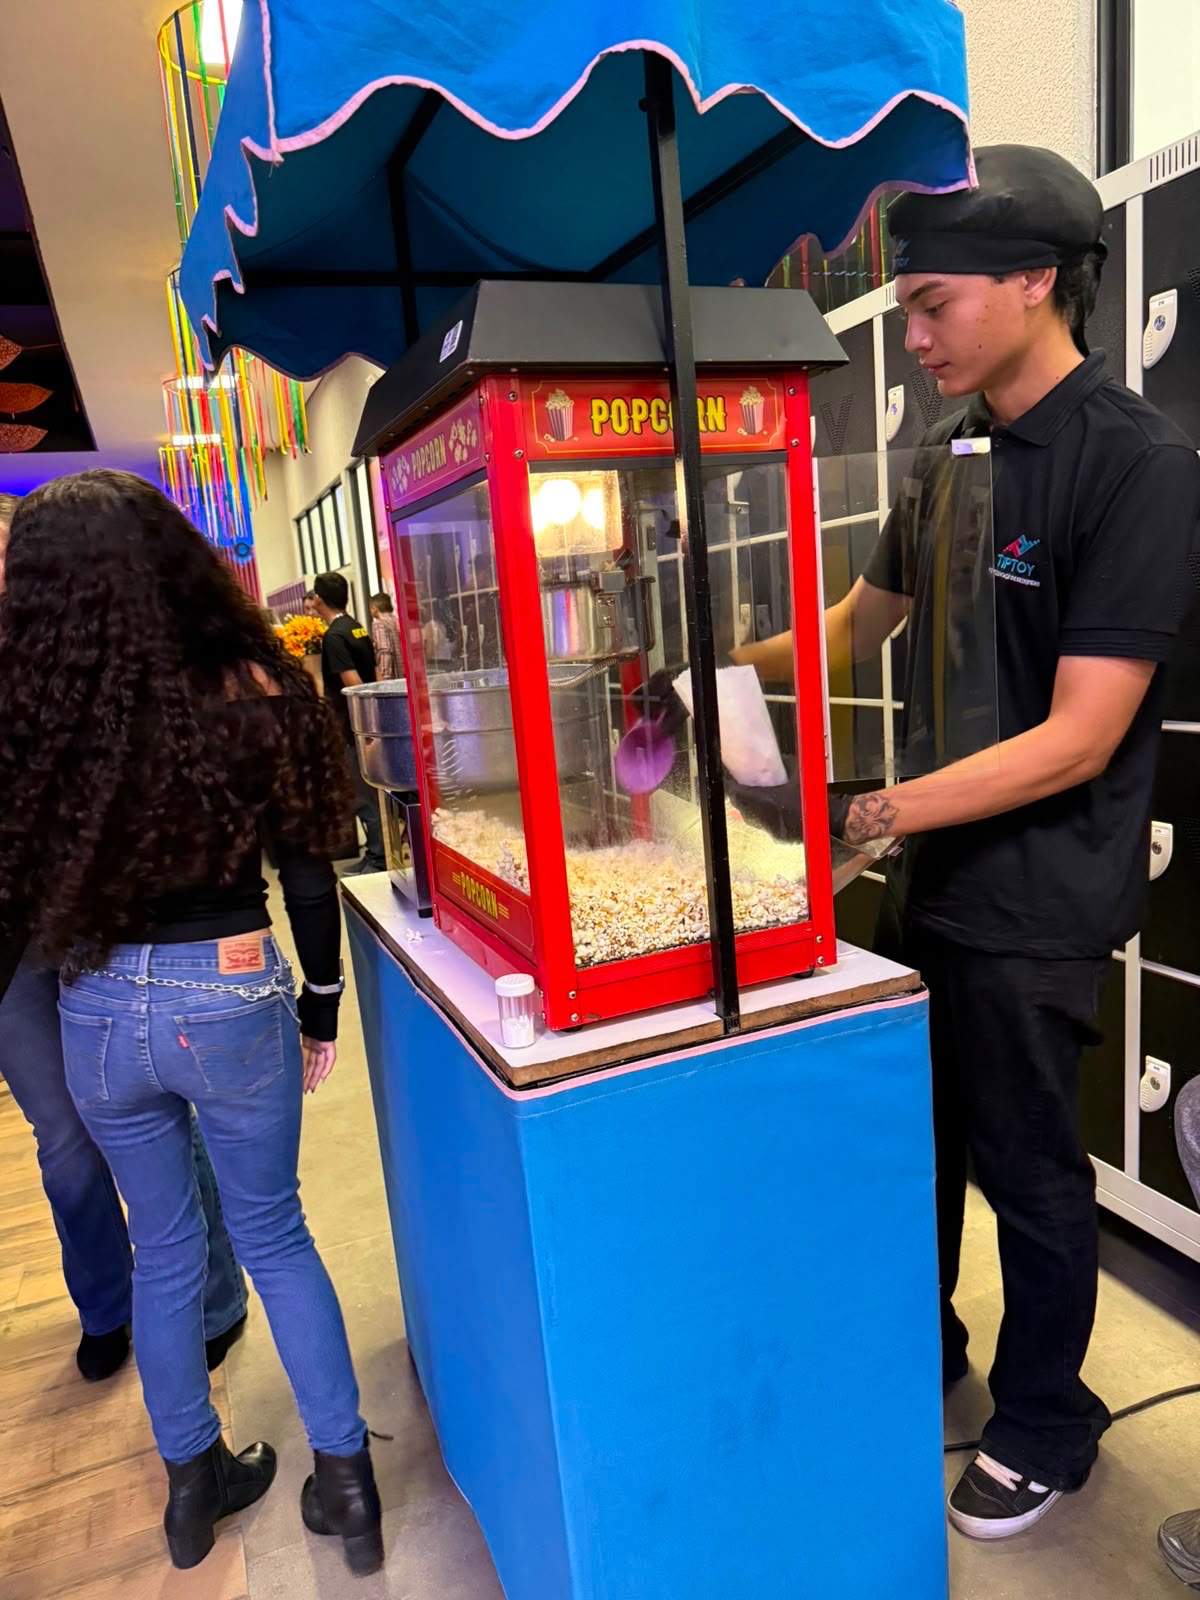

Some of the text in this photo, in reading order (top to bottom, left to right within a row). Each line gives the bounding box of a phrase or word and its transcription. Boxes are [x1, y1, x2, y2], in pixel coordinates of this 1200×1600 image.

[590, 396, 727, 436] POPCRN
[411, 432, 447, 482] POPCORN
[997, 553, 1035, 577] TIPTOY
[460, 871, 498, 919] POPCORN
